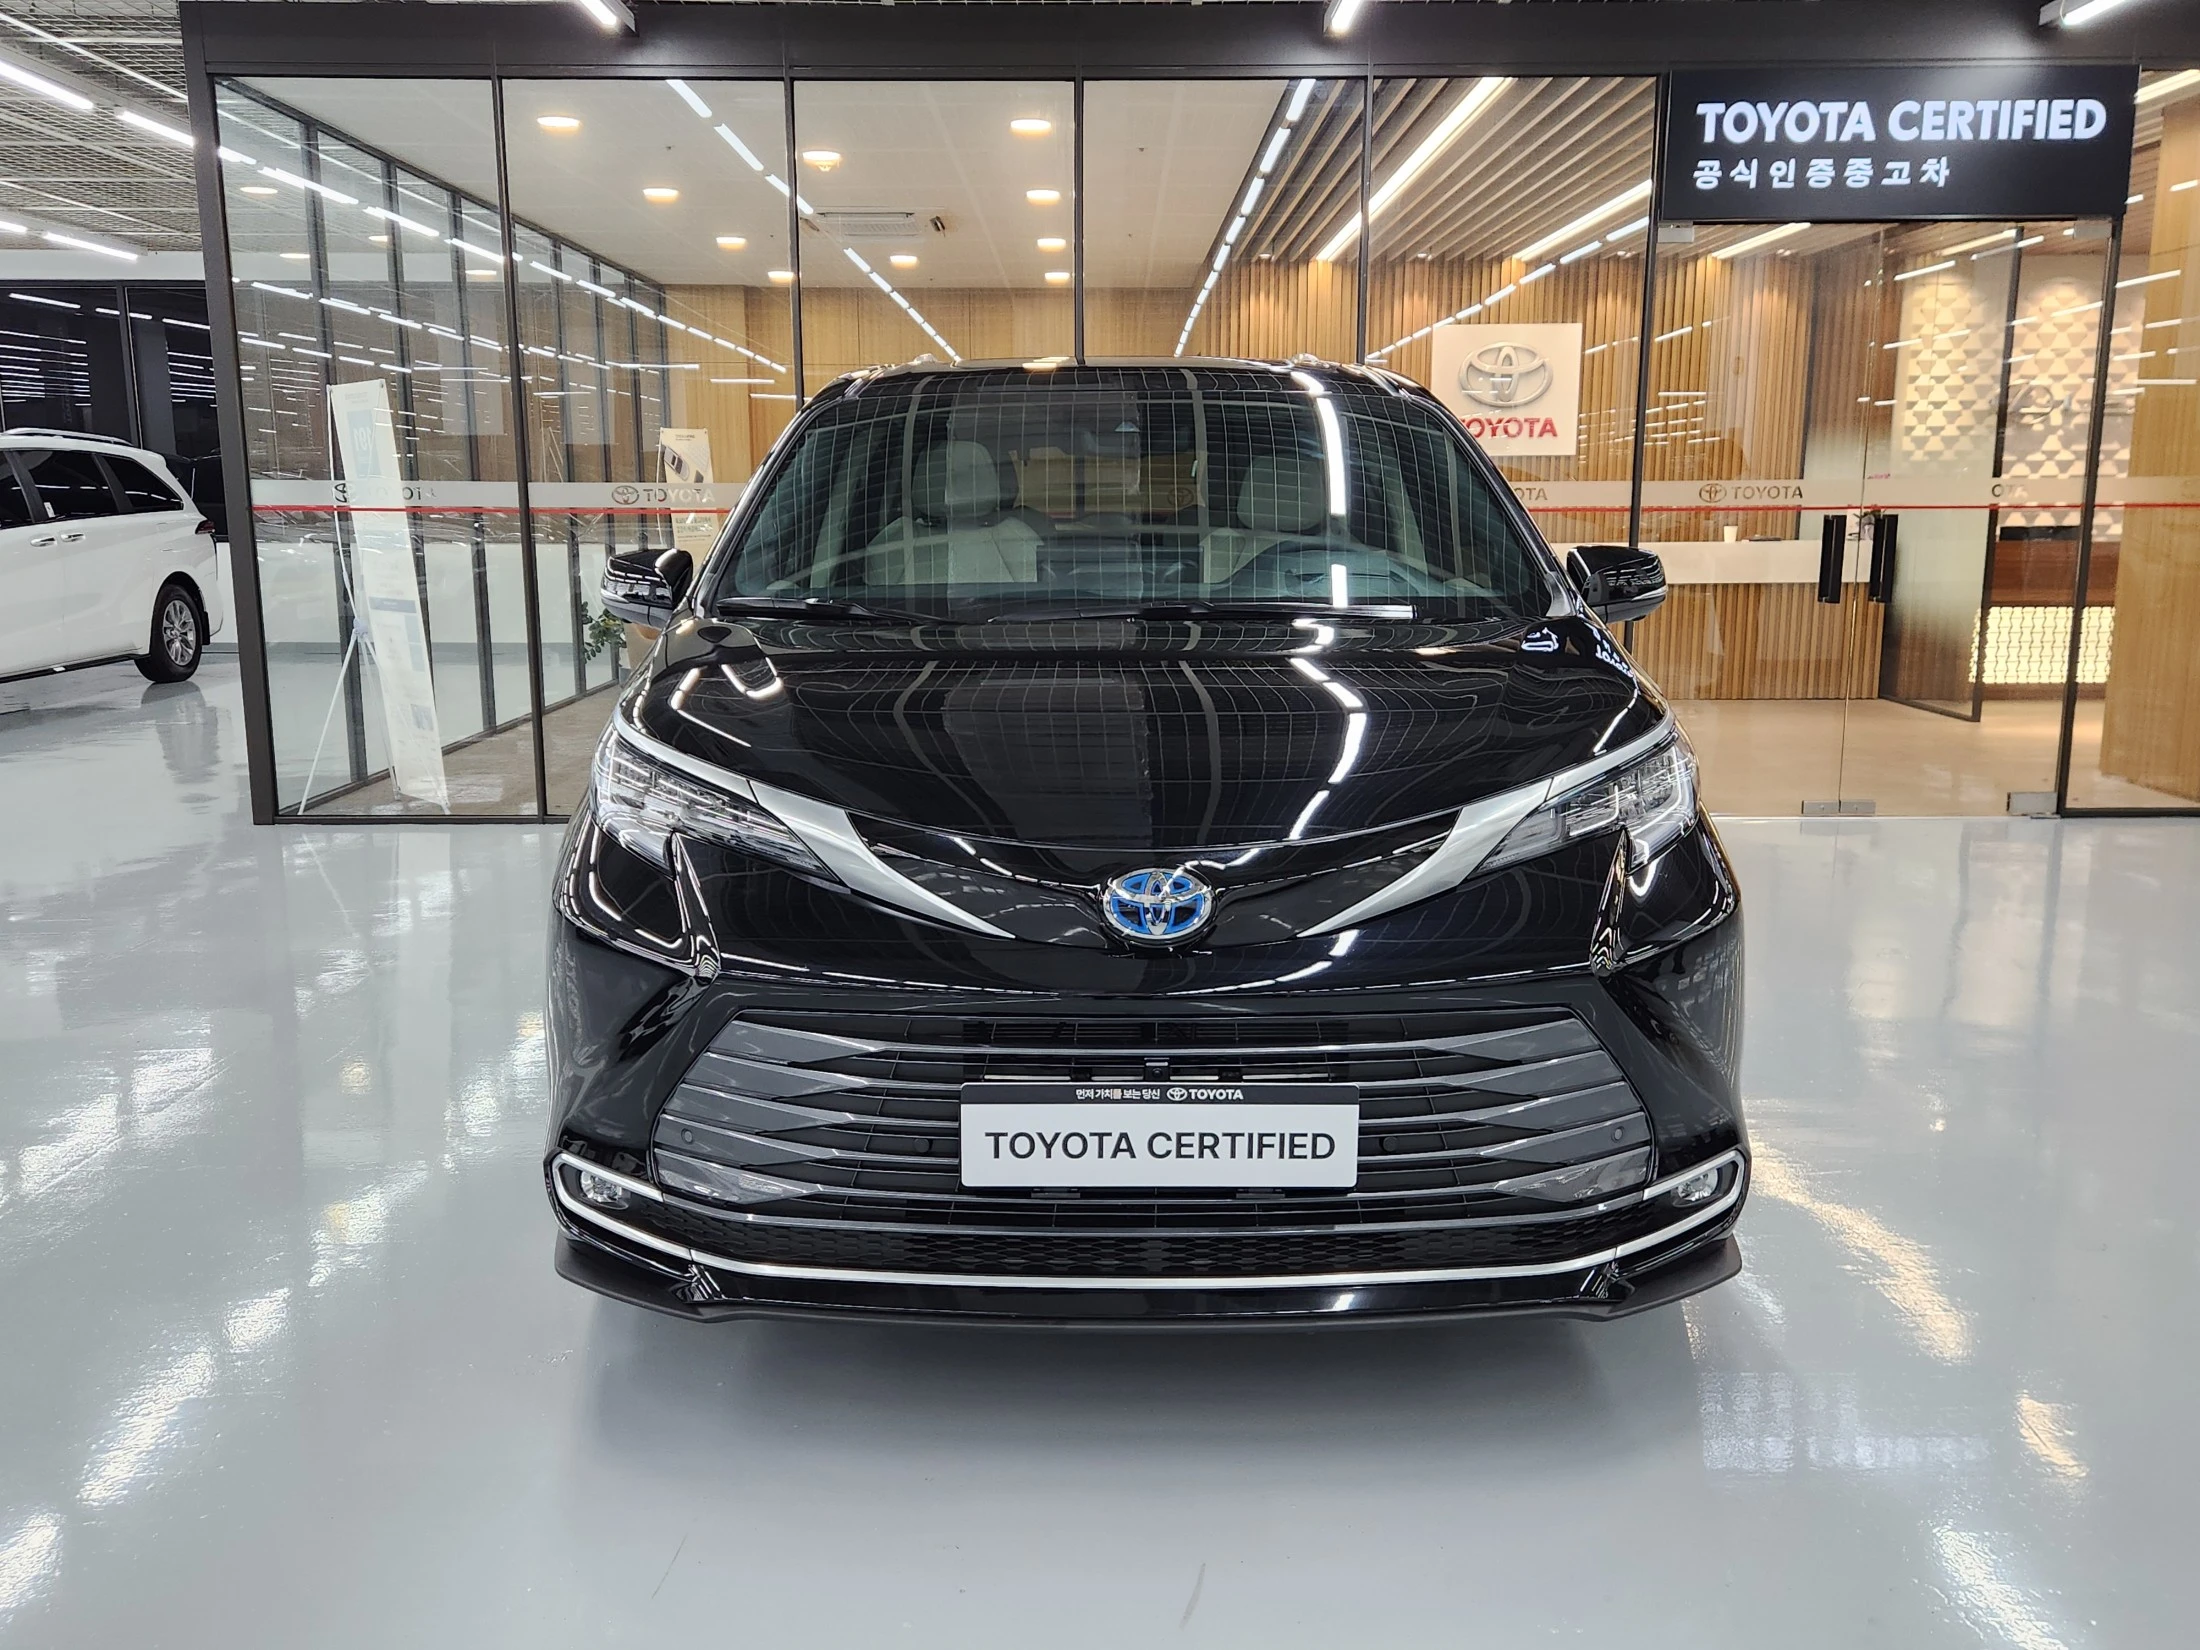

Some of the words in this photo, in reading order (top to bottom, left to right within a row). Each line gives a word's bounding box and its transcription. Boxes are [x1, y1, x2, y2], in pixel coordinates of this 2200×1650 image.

[1696, 99, 1876, 144] TOYOTA
[1887, 98, 2107, 141] CERTIFIED
[1692, 157, 1951, 190] 공식인증중고차
[643, 488, 716, 503] TOYOTA
[1732, 486, 1803, 500] TOYOTA
[1076, 1088, 1094, 1100] 먼저
[1095, 1088, 1122, 1100] 가치를
[1123, 1088, 1141, 1100] 보는
[1142, 1088, 1160, 1100] 당신
[1189, 1089, 1244, 1100] TOYOTA
[985, 1131, 1136, 1159] TOYOTA
[1147, 1131, 1336, 1159] CERTIFIED
